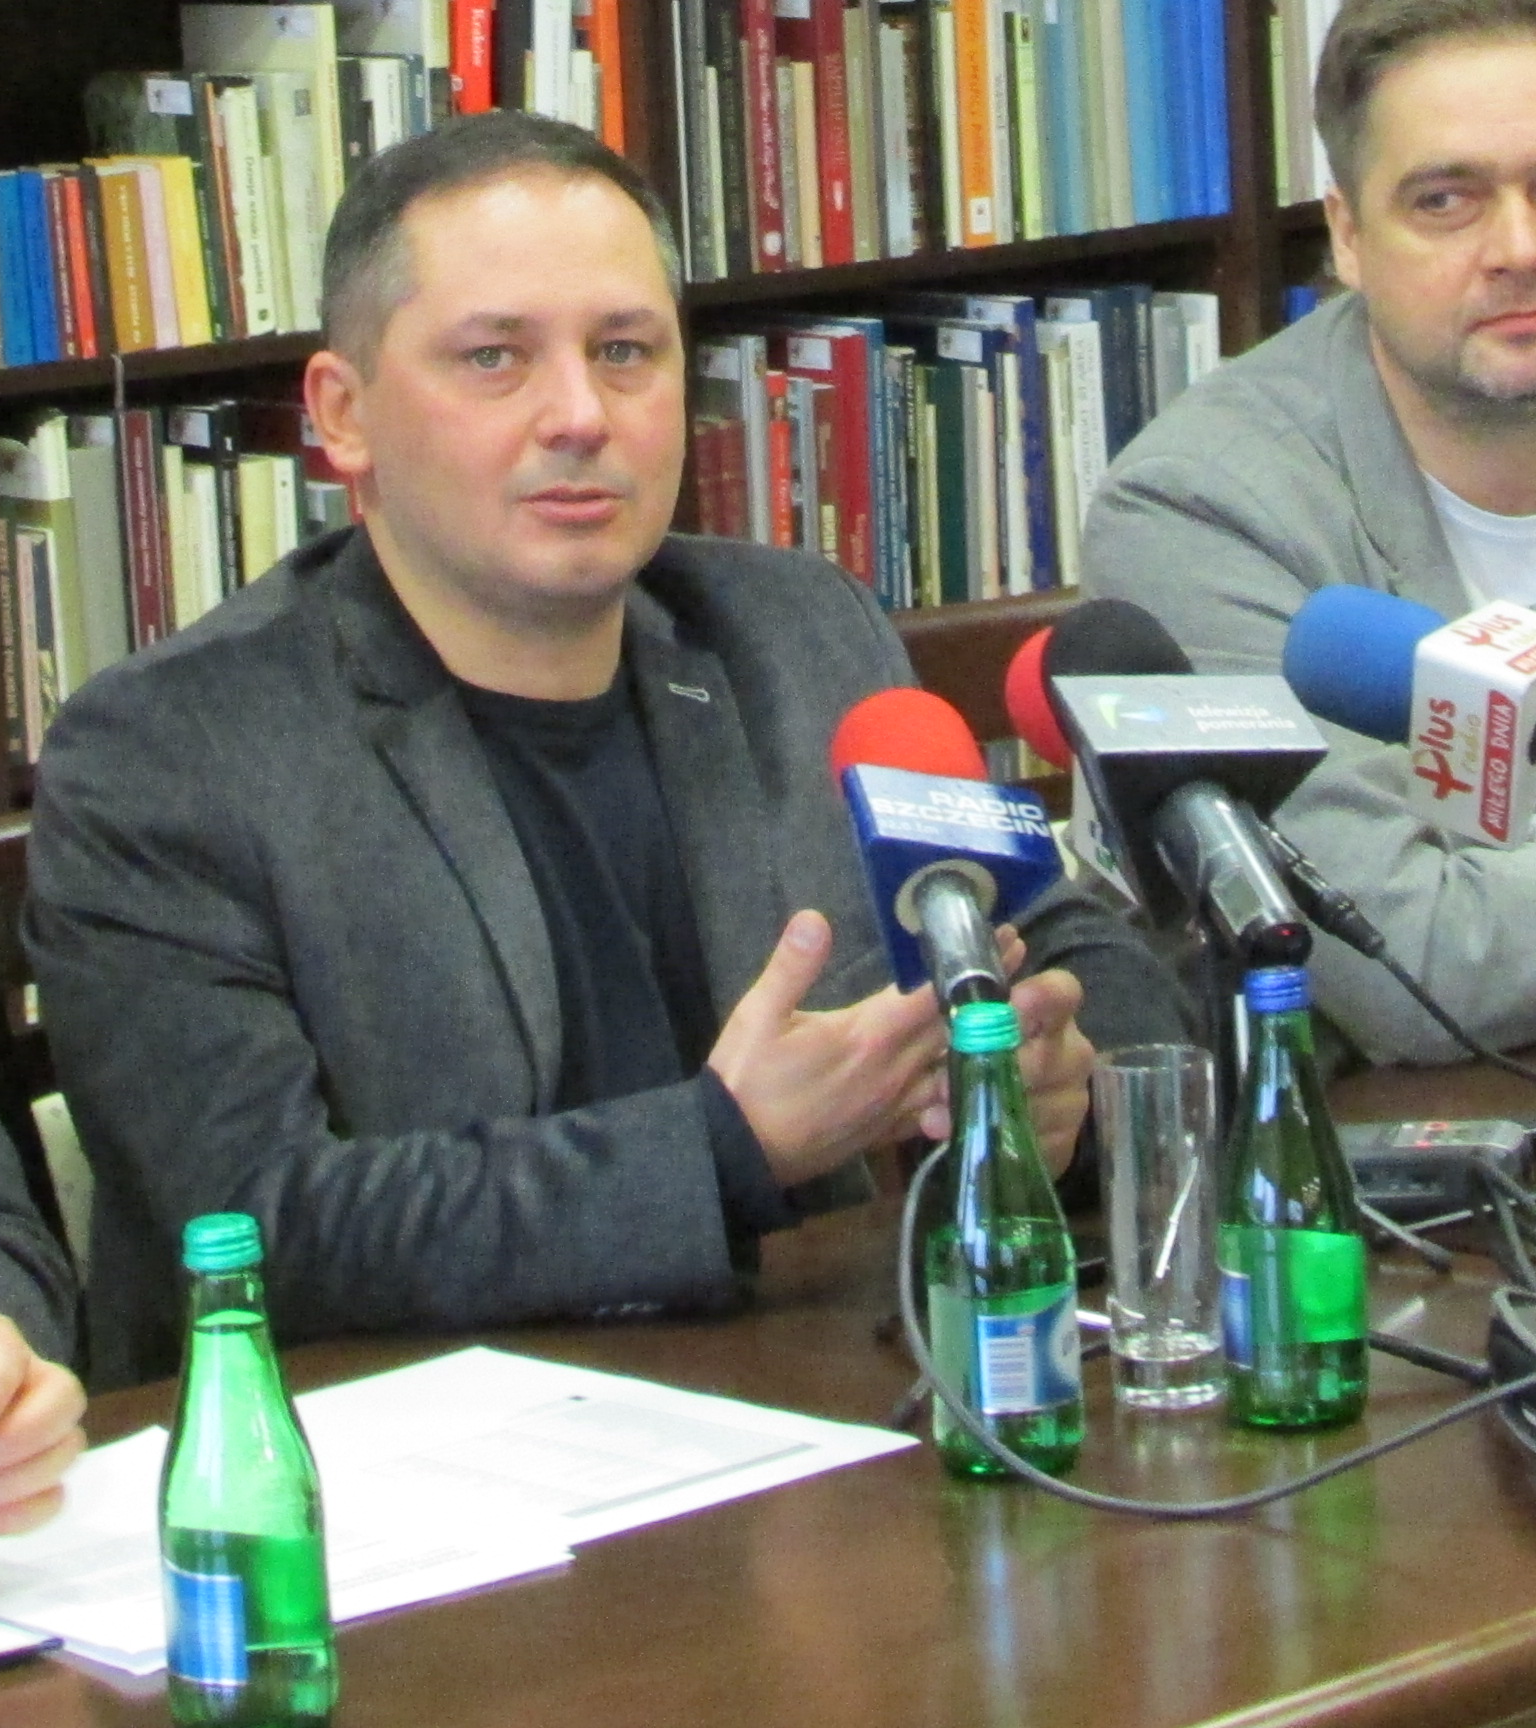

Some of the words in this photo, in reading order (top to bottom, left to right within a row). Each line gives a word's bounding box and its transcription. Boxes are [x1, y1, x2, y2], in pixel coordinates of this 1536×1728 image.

[472, 8, 485, 68] Kraków
[1187, 704, 1270, 720] telewizja
[1195, 716, 1297, 734] pomerania
[1491, 702, 1513, 750] DNIA
[928, 789, 1045, 821] RADIO
[1488, 759, 1512, 830] MIŁEGO
[869, 797, 1050, 838] SZCZECIN
